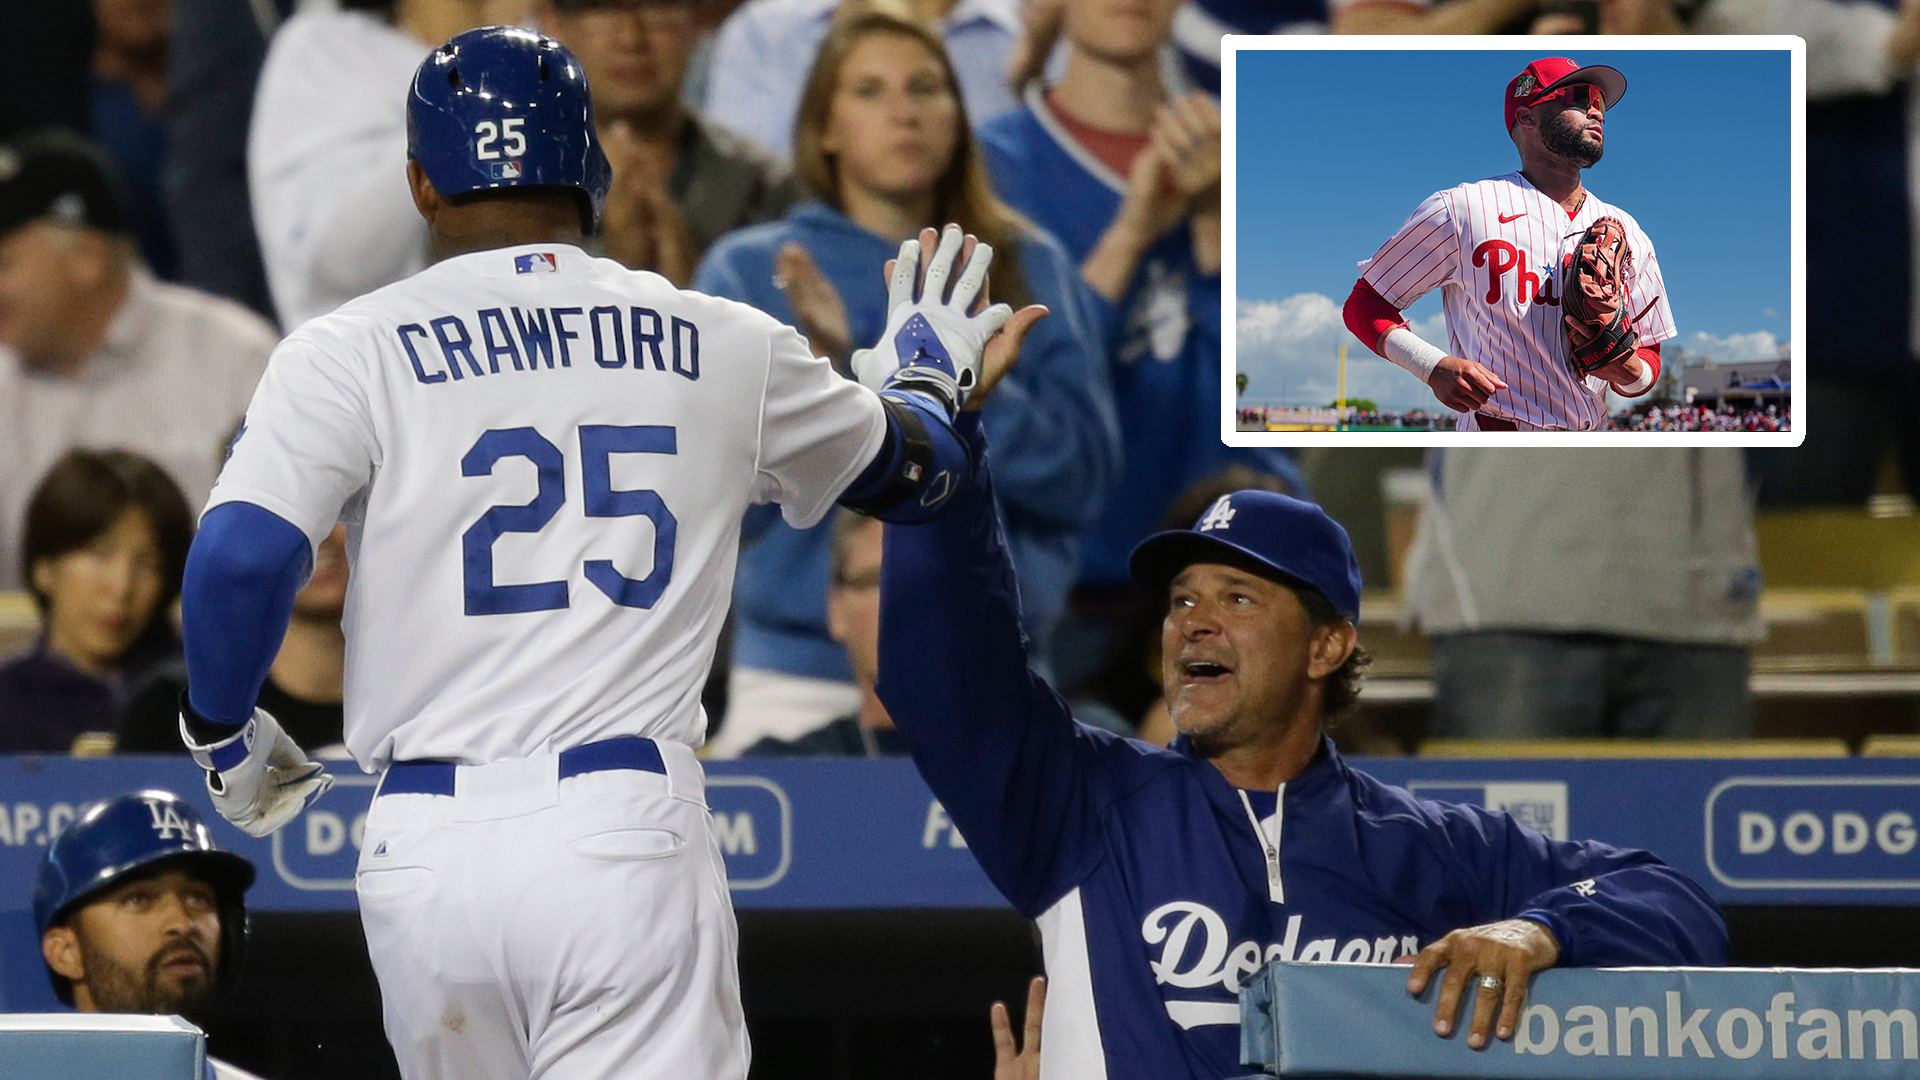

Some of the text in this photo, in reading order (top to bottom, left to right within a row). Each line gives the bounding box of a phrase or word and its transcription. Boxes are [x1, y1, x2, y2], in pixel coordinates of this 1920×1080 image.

[475, 118, 527, 160] 25
[397, 305, 700, 385] CRAWFORD
[461, 425, 677, 616] 25
[1201, 494, 1237, 531] LA
[145, 800, 193, 840] LA
[1738, 811, 1918, 855] DODG
[1514, 990, 1920, 1061] bankofam
